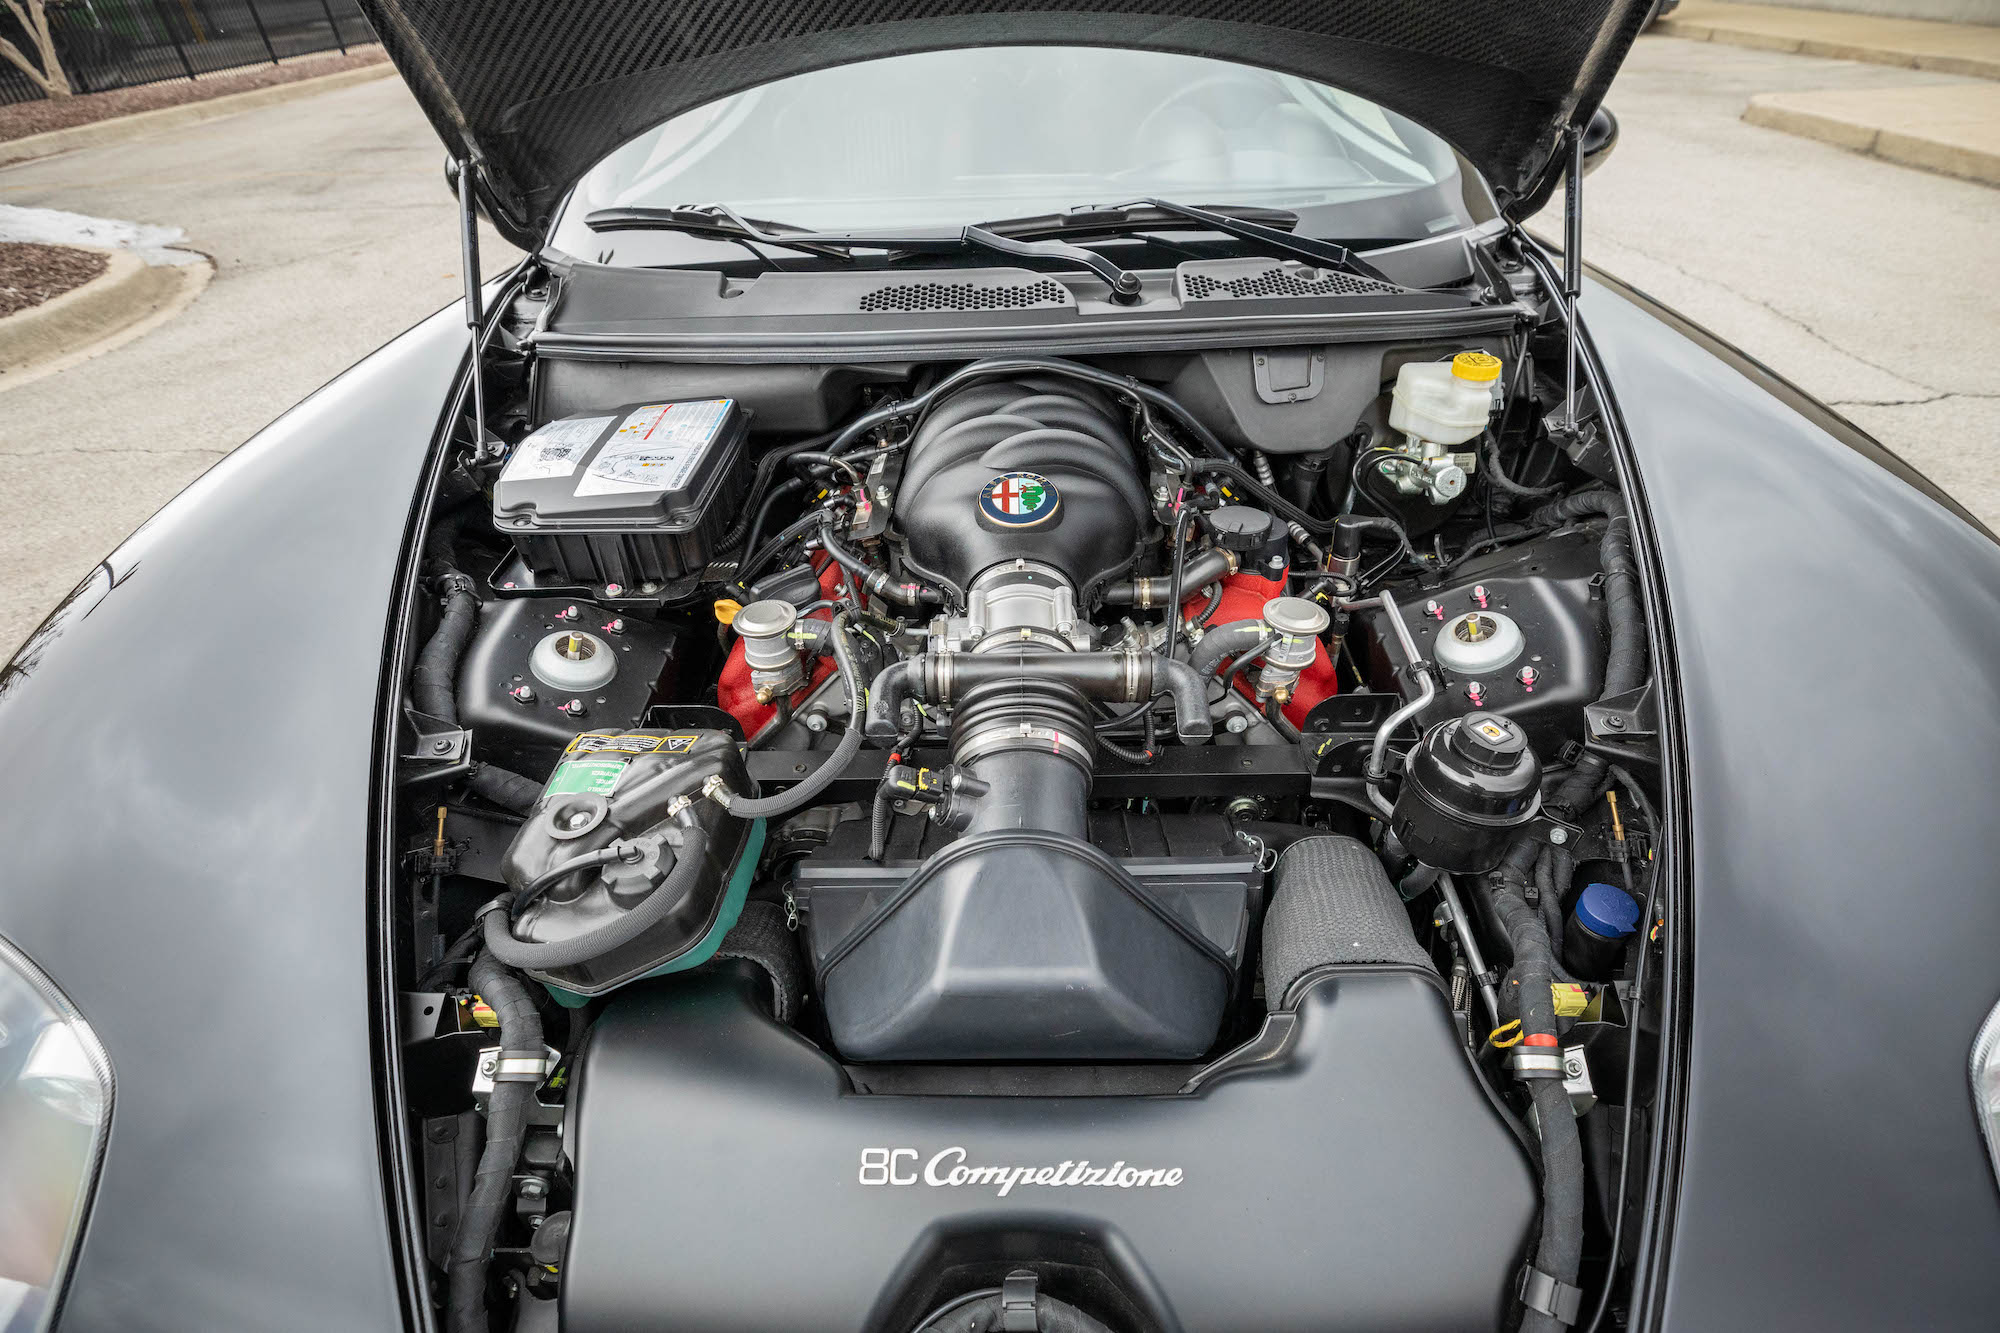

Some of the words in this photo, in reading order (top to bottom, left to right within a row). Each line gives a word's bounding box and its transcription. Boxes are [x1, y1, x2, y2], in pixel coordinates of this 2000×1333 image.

[982, 475, 1009, 499] ALFA
[858, 1147, 919, 1186] 8C
[923, 1146, 1184, 1197] Competizione
